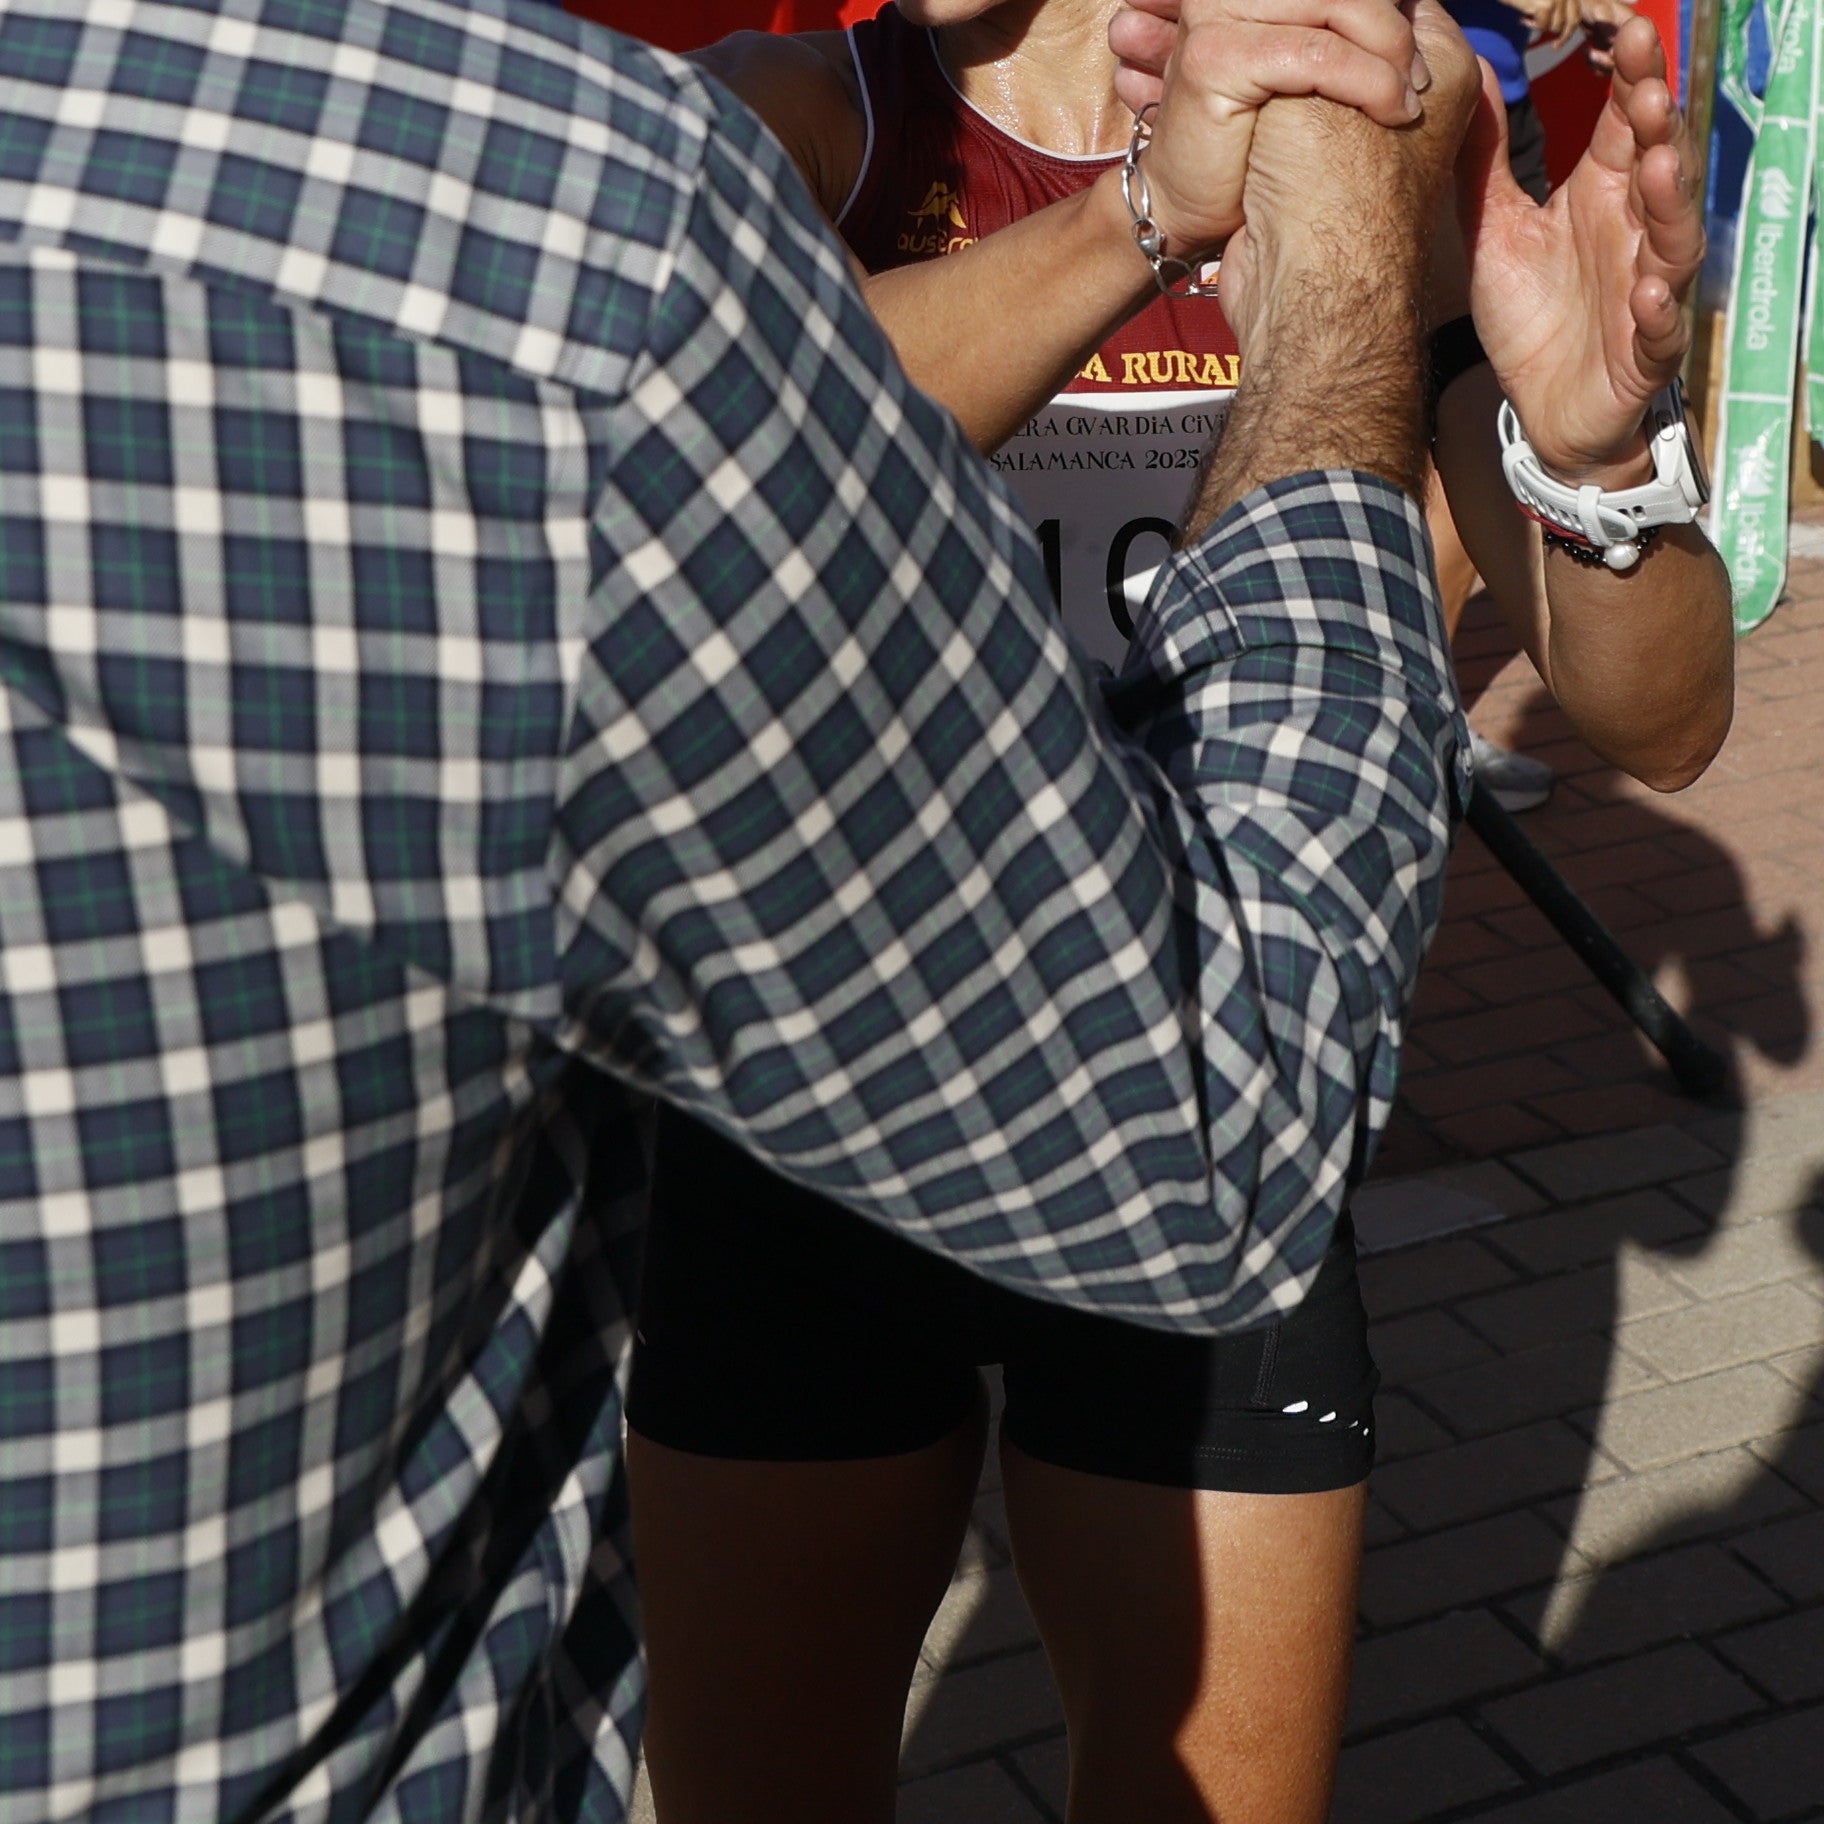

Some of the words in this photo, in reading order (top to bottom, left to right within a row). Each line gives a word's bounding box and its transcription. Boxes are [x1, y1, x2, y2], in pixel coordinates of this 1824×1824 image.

[1745, 222, 1786, 352] Iberdrola
[989, 449, 1135, 473] SALAMANCA
[1144, 448, 1200, 471] 2025
